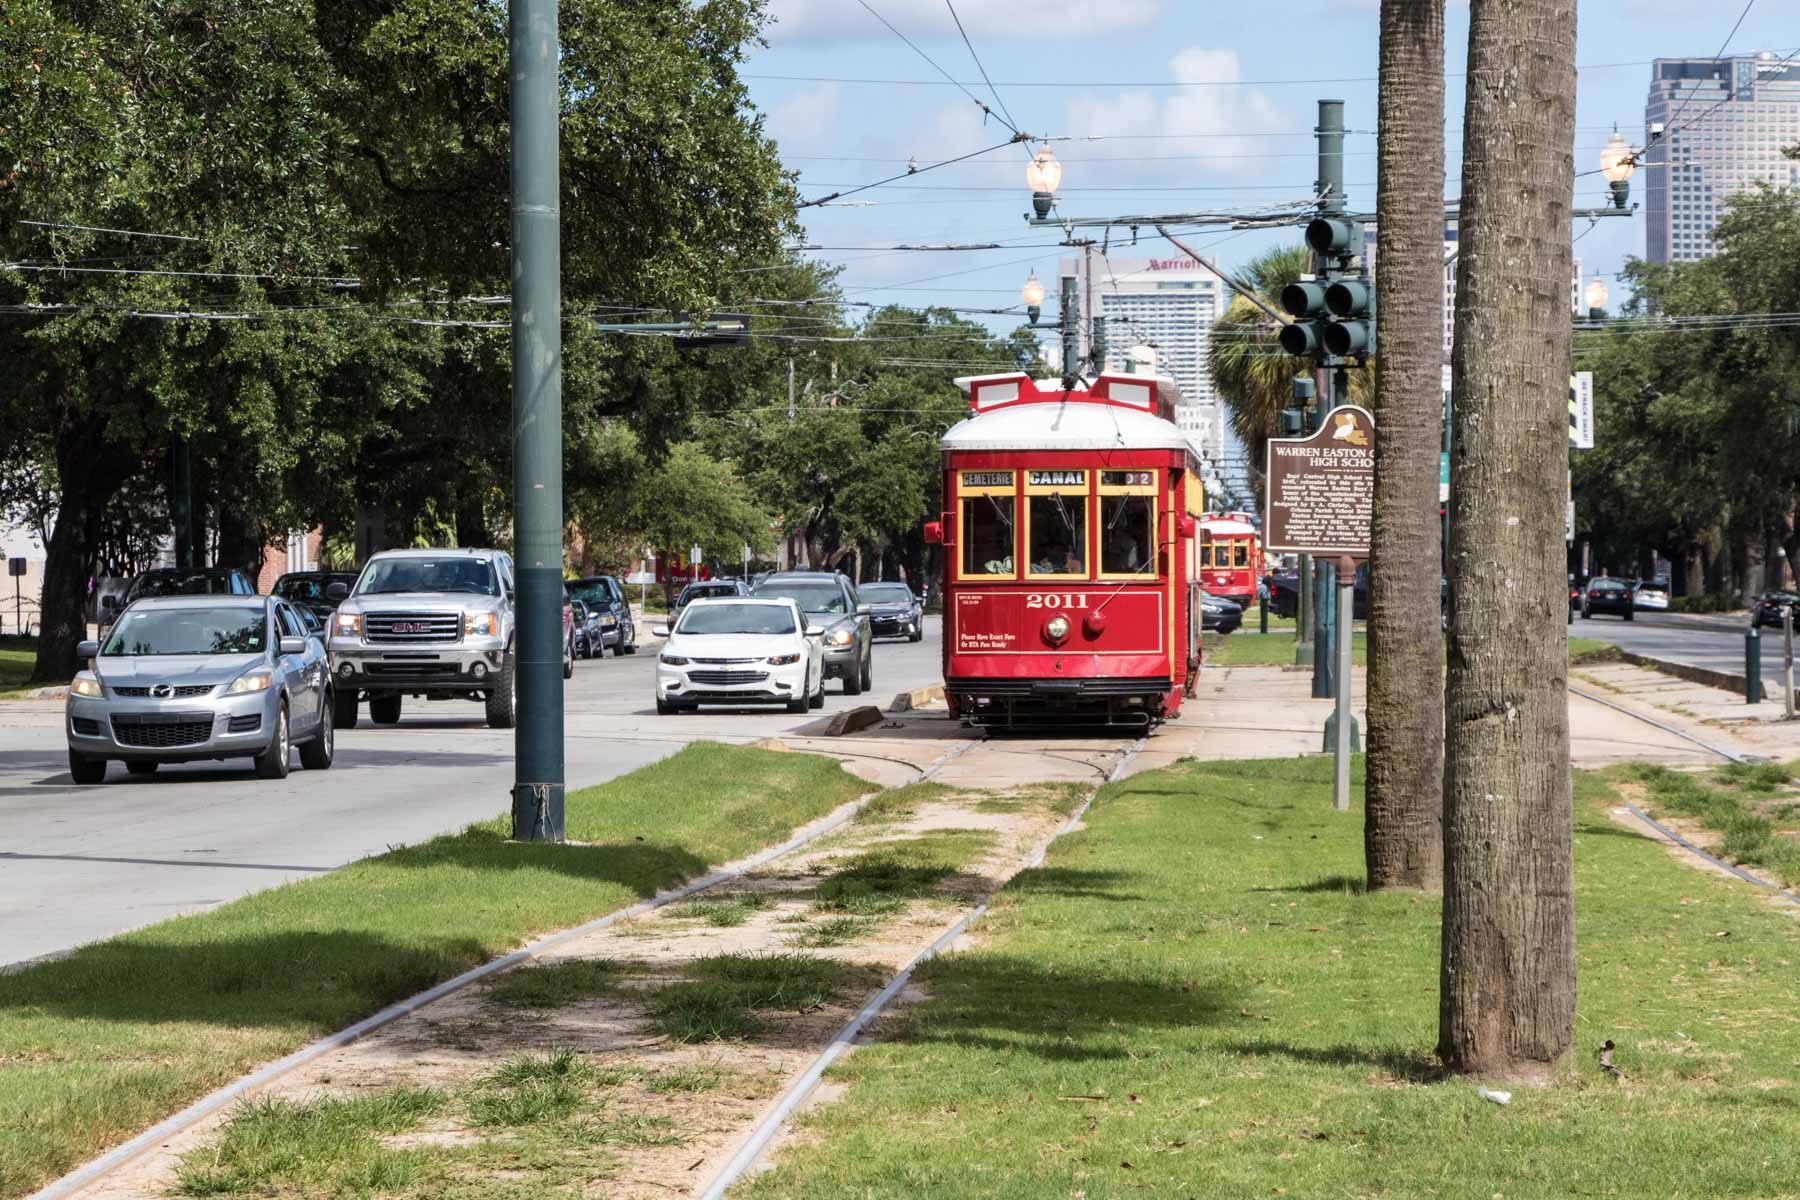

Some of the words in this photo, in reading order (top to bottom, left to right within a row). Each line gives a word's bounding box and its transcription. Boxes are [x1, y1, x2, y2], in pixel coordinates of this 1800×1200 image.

[1276, 447, 1320, 456] WARREN
[1323, 448, 1366, 458] EASTON
[1310, 457, 1338, 467] HIGH
[1030, 472, 1084, 484] CANAL
[1026, 594, 1088, 608] 2011
[392, 622, 432, 632] GMC
